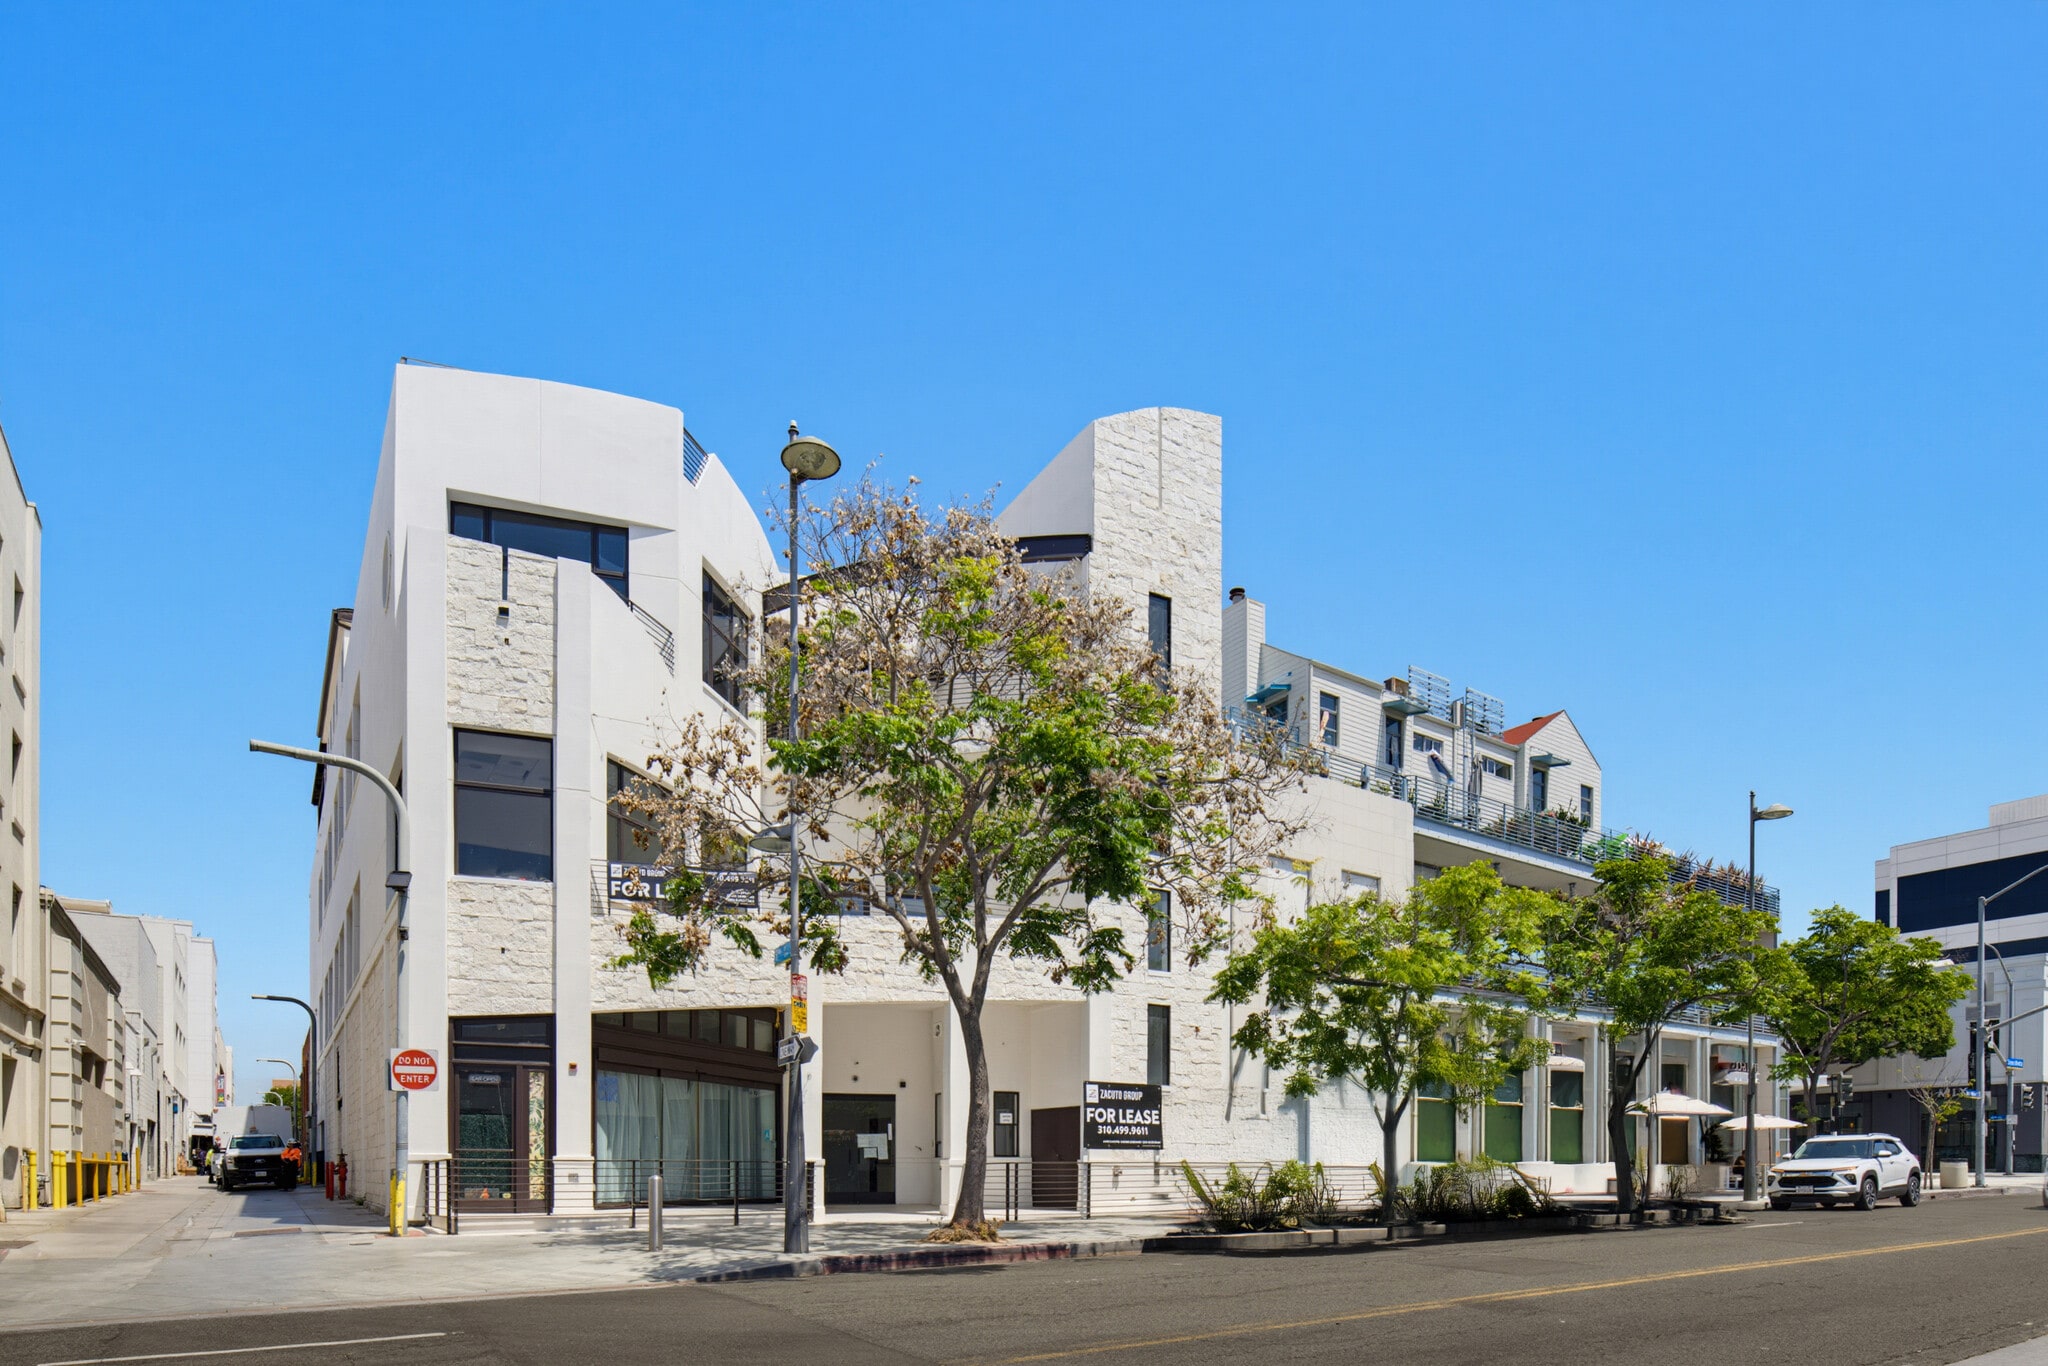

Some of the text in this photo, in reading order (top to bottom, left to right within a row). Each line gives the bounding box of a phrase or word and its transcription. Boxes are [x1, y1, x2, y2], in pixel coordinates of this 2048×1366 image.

[610, 881, 651, 898] FOR
[398, 1056, 431, 1065] DO NOT
[400, 1074, 430, 1083] ENTER
[1123, 1090, 1143, 1101] GROUP
[1086, 1107, 1160, 1125] FOR LEASE
[1097, 1125, 1149, 1136] 310.499.9611
